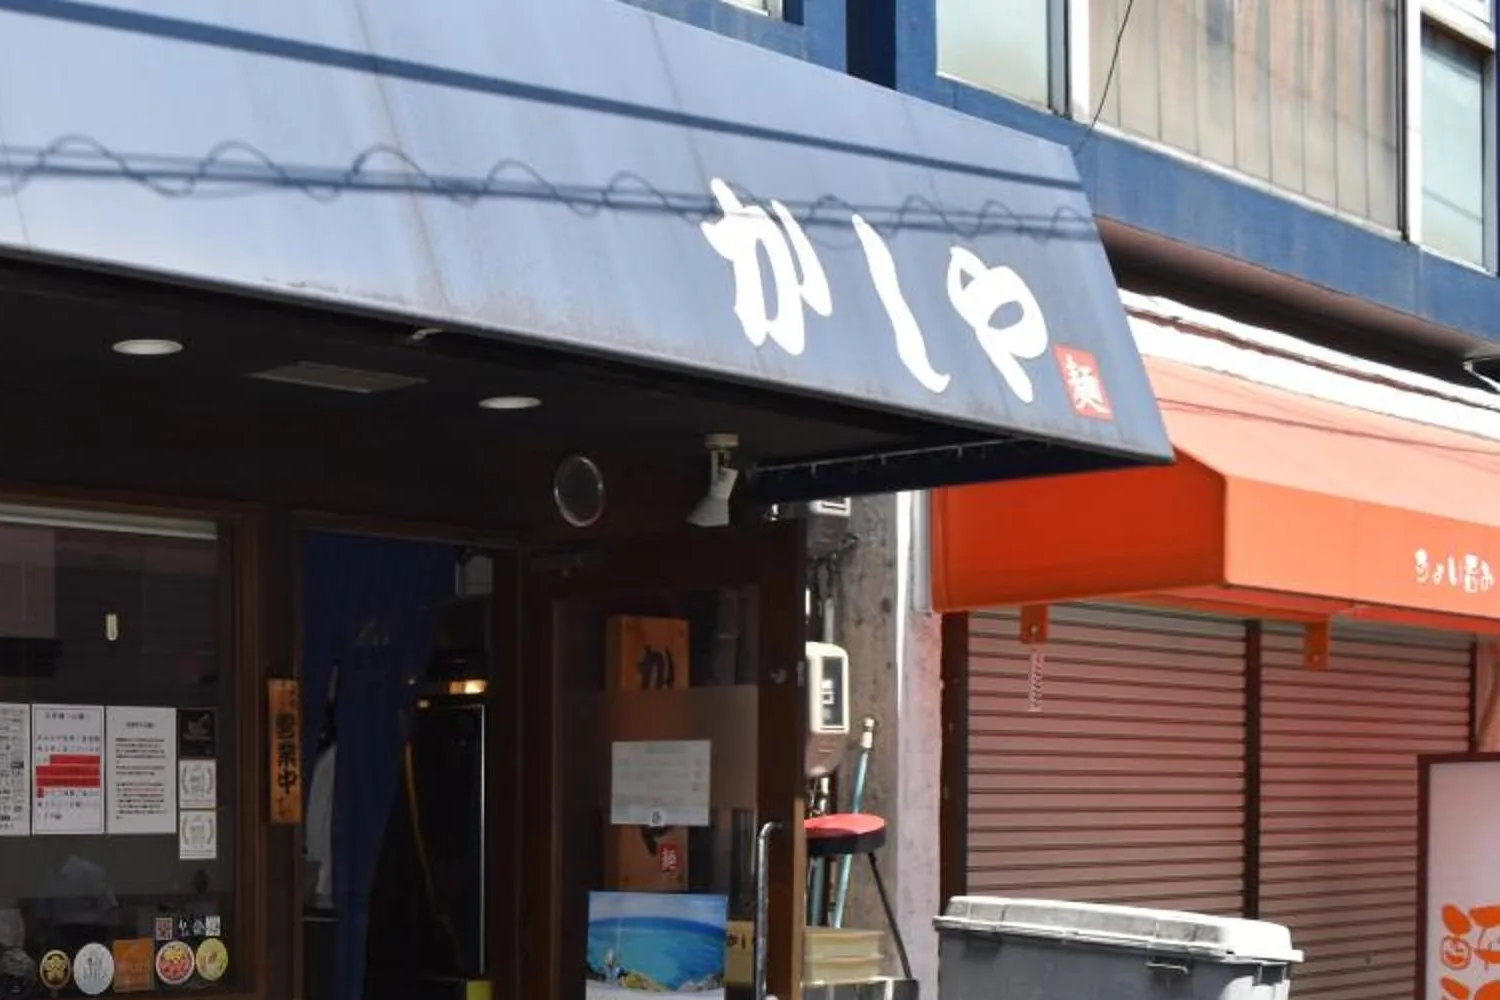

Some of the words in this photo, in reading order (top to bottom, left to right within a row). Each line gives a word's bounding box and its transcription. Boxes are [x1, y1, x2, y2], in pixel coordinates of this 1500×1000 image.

[700, 177, 1049, 404] かしや
[1060, 350, 1112, 418] 麺
